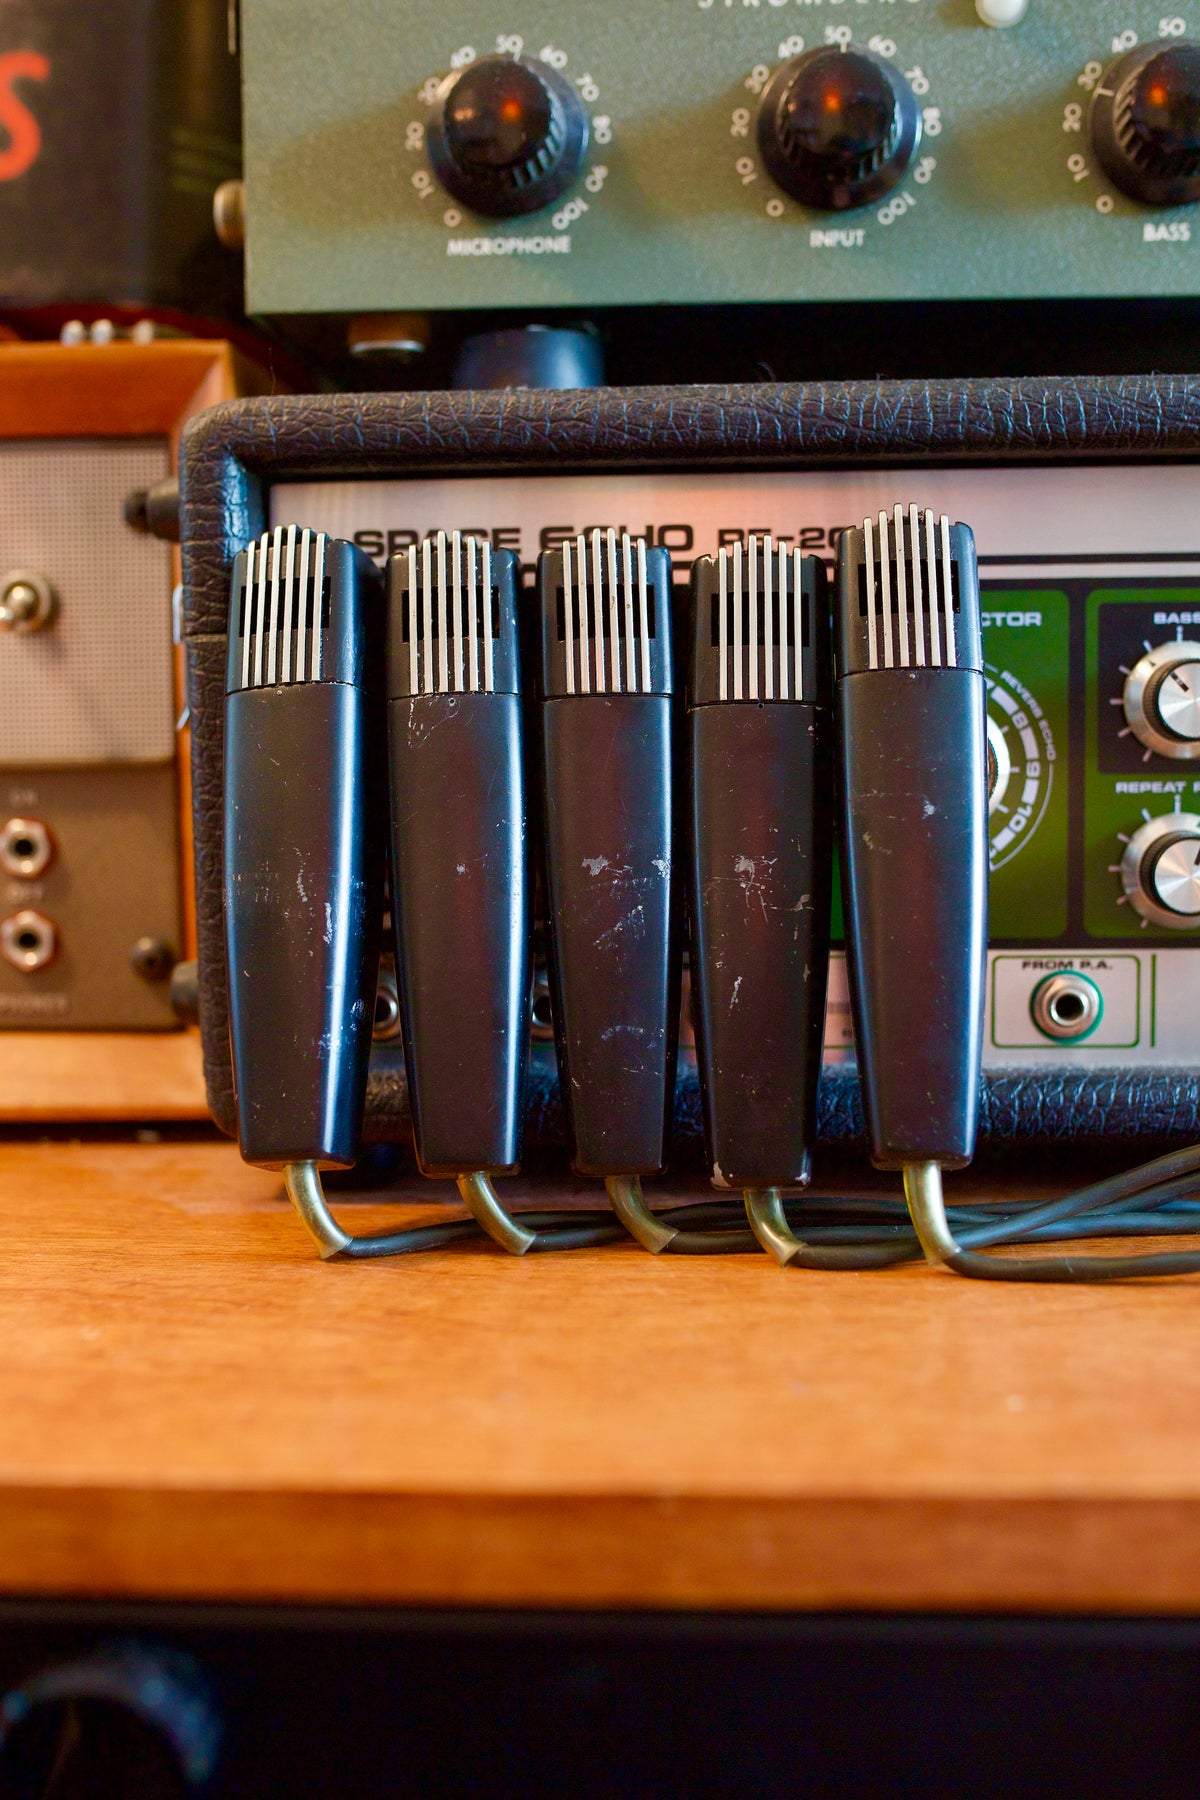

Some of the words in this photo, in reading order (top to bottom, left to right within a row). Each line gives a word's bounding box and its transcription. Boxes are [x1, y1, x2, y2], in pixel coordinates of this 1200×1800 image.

[1158, 17, 1186, 38] 50
[877, 191, 917, 225] 100
[809, 228, 866, 248] INPUT
[1143, 222, 1192, 242] BASS
[447, 235, 571, 256] MICROPHONE
[981, 611, 1042, 627] CTOR
[1115, 781, 1187, 794] REPEAT
[1022, 959, 1073, 970] FROM
